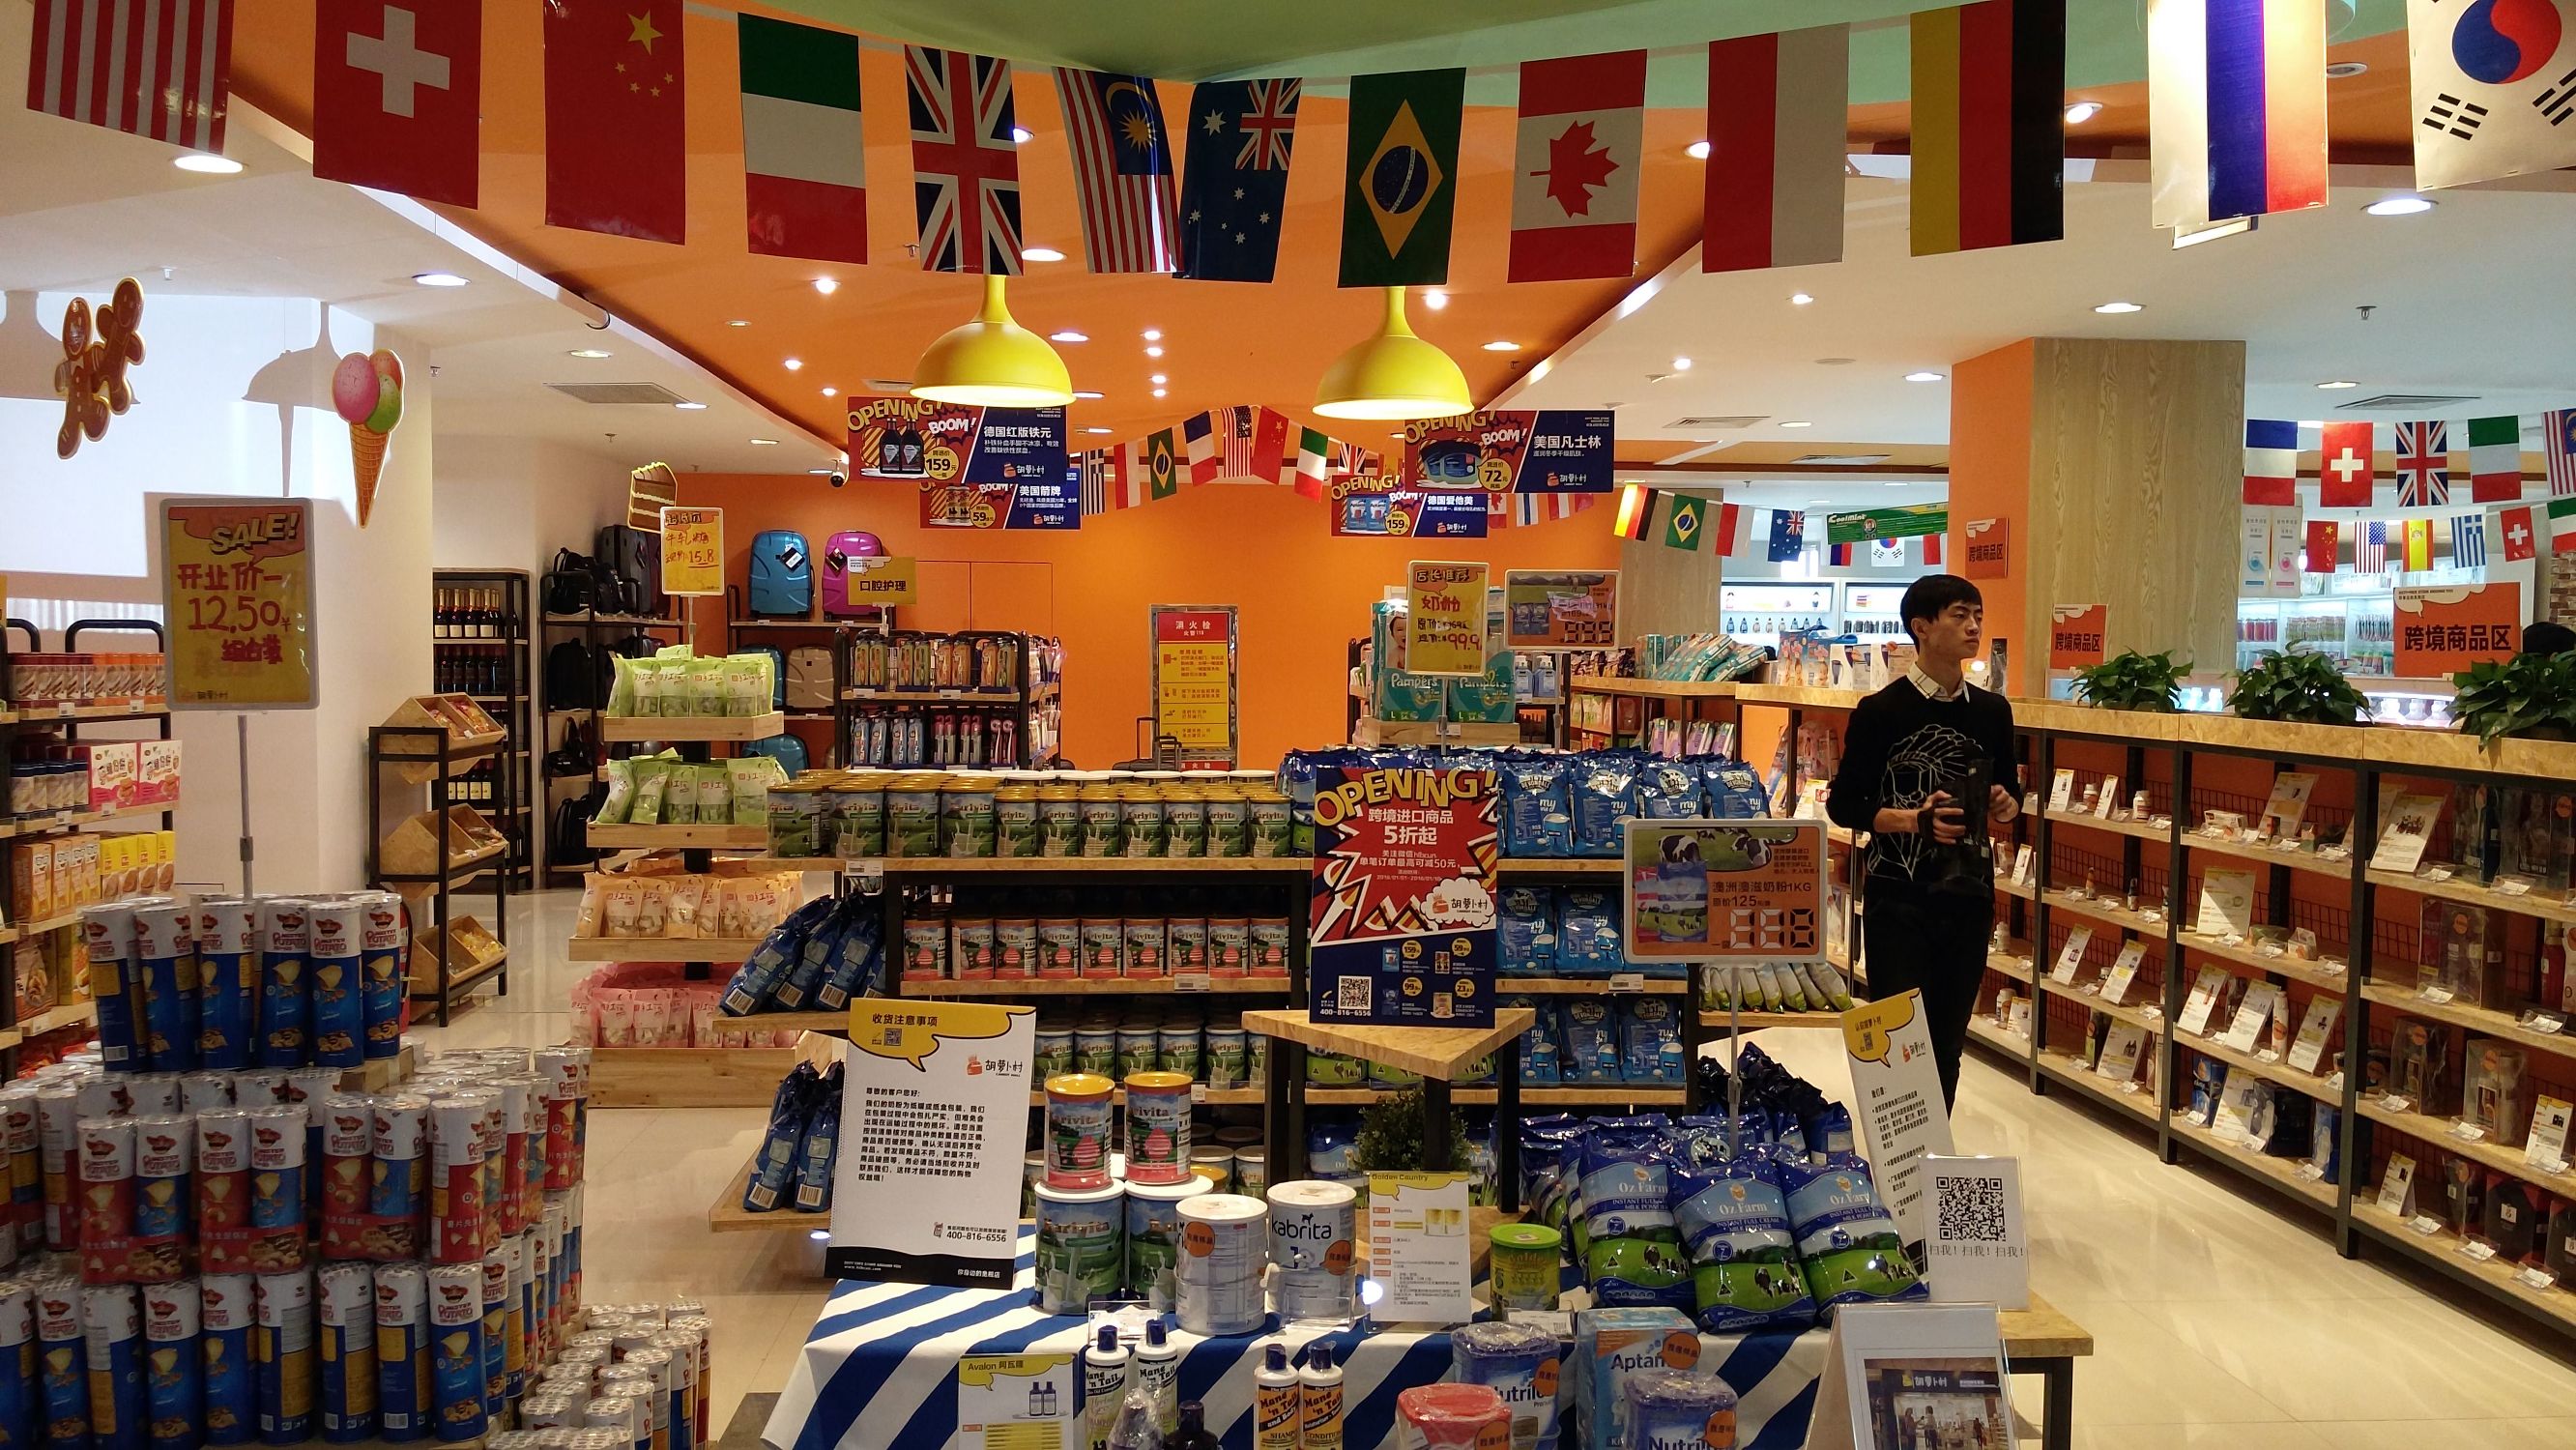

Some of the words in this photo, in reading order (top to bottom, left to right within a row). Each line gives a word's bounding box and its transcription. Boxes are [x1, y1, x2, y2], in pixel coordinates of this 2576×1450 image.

[929, 417, 976, 435] BOOM!
[984, 426, 1052, 438] 德国红版铁元
[1481, 428, 1527, 446] BOOM!
[1533, 435, 1602, 450] 美国凡士林
[1017, 464, 1045, 475] 胡萝卜村
[1559, 474, 1587, 483] 胡萝卜村
[1019, 485, 1061, 496] 美国箭牌
[1331, 475, 1401, 500] OPENING!
[1428, 495, 1474, 506] 德国爱他美
[209, 512, 301, 556] SALE!
[689, 548, 714, 563] 15.8
[1968, 543, 2004, 563] 跨境商品区
[859, 580, 907, 592] 口腔护理
[1421, 595, 1462, 613] 奶粉
[1175, 620, 1211, 629] 消火栓
[2054, 632, 2101, 652] 跨境商品区
[2404, 624, 2512, 652] 跨境商品区
[1391, 673, 1438, 689] Pampers
[1315, 768, 1497, 827] OPENING!
[1368, 808, 1454, 825] 跨境进口商品
[1383, 826, 1438, 846] 5折起
[1451, 897, 1488, 910] 胡萝卜村
[872, 1012, 939, 1027] 收货注意事项
[1319, 1008, 1372, 1017] 400-816-6556
[985, 1059, 1023, 1073] 胡萝卜村
[1399, 1174, 1429, 1183] Country
[1618, 1182, 1635, 1194] Oz
[1637, 1181, 1668, 1193] Farm
[1719, 1204, 1736, 1215] Oz
[1738, 1203, 1768, 1213] Farm
[1272, 1214, 1332, 1240] kabrita
[946, 1231, 1007, 1242] 400-816-6556
[1140, 1366, 1166, 1378] Mane
[1159, 1365, 1175, 1380] Tail
[1098, 1374, 1119, 1386] Tail
[1259, 1392, 1288, 1409] Mane
[1304, 1392, 1332, 1408] Mane
[1267, 1417, 1282, 1428] and
[1648, 1436, 1706, 1450] Nutril
